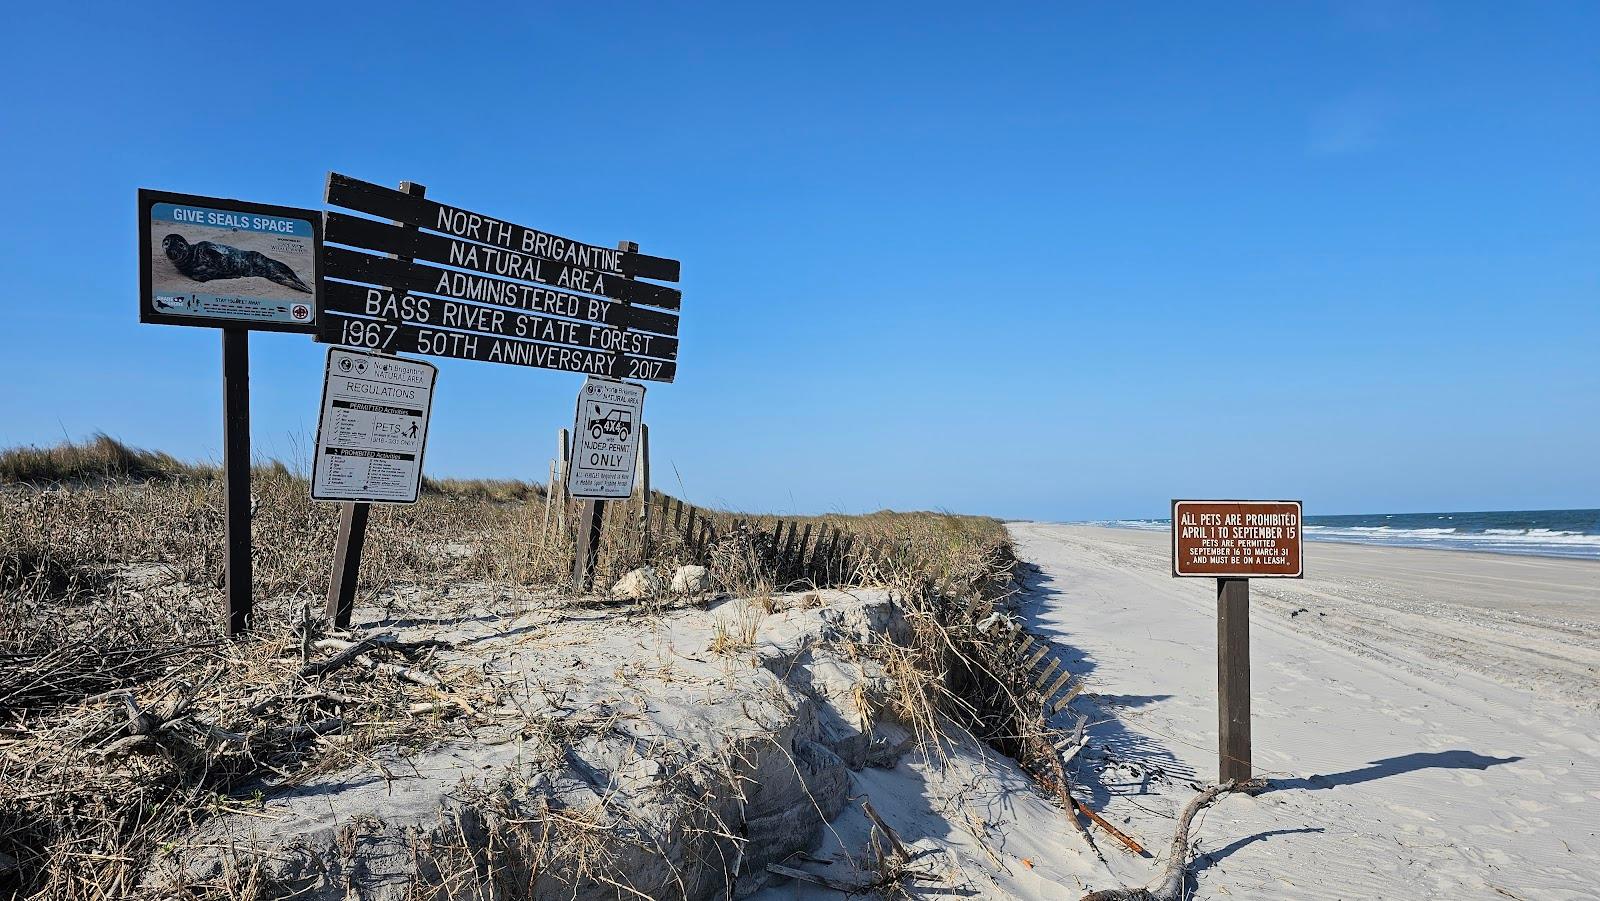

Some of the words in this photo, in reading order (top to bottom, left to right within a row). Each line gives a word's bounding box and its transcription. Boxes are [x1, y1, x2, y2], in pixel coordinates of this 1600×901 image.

[174, 209, 203, 222] GIVE
[208, 213, 249, 228] SEALS
[254, 217, 294, 233] SPACE
[437, 207, 511, 247] NORTH
[522, 231, 624, 272] BRIGANTINE
[450, 242, 546, 282] NATURAL
[558, 266, 605, 293] AREA
[436, 272, 578, 317] ADMINISTERED
[588, 300, 610, 321] BY
[365, 290, 430, 321] BASS
[443, 303, 504, 332] RIVER
[516, 317, 578, 345] STATE
[589, 327, 653, 354] FOREST
[342, 320, 398, 348] 1967
[417, 330, 477, 358] 50TH
[489, 341, 616, 375] ANNIVERSARY
[629, 360, 662, 379] 2017
[375, 371, 405, 381] NATURAL
[407, 376, 424, 384] AREA
[346, 381, 415, 400] REGULATIONS
[603, 394, 626, 402] NATURAL
[350, 402, 383, 413] PERMITTED
[384, 407, 409, 416] Activities
[375, 422, 401, 434] PETS
[604, 421, 621, 433] 4X4
[584, 441, 606, 450] NJDEP
[609, 443, 630, 453] PERMIT
[341, 450, 375, 458] PROHIBITED
[377, 452, 401, 460] Activities
[591, 453, 622, 467] ONLY
[1181, 514, 1197, 526] ALL
[1201, 514, 1220, 526] PETS
[1225, 514, 1242, 526] ARE
[1246, 514, 1296, 526] PROHIBITED
[1182, 528, 1207, 538] APRIL
[1211, 528, 1214, 538] 1
[1218, 528, 1228, 538] TO
[1233, 527, 1282, 538] SEPTEMBER
[1286, 528, 1295, 539] 15
[1255, 548, 1278, 556] MARCH
[1282, 548, 1288, 556] 31
[1193, 556, 1206, 564] AND
[1210, 556, 1228, 564] MUST
[1231, 556, 1240, 564] BE
[1244, 556, 1253, 564] ON
